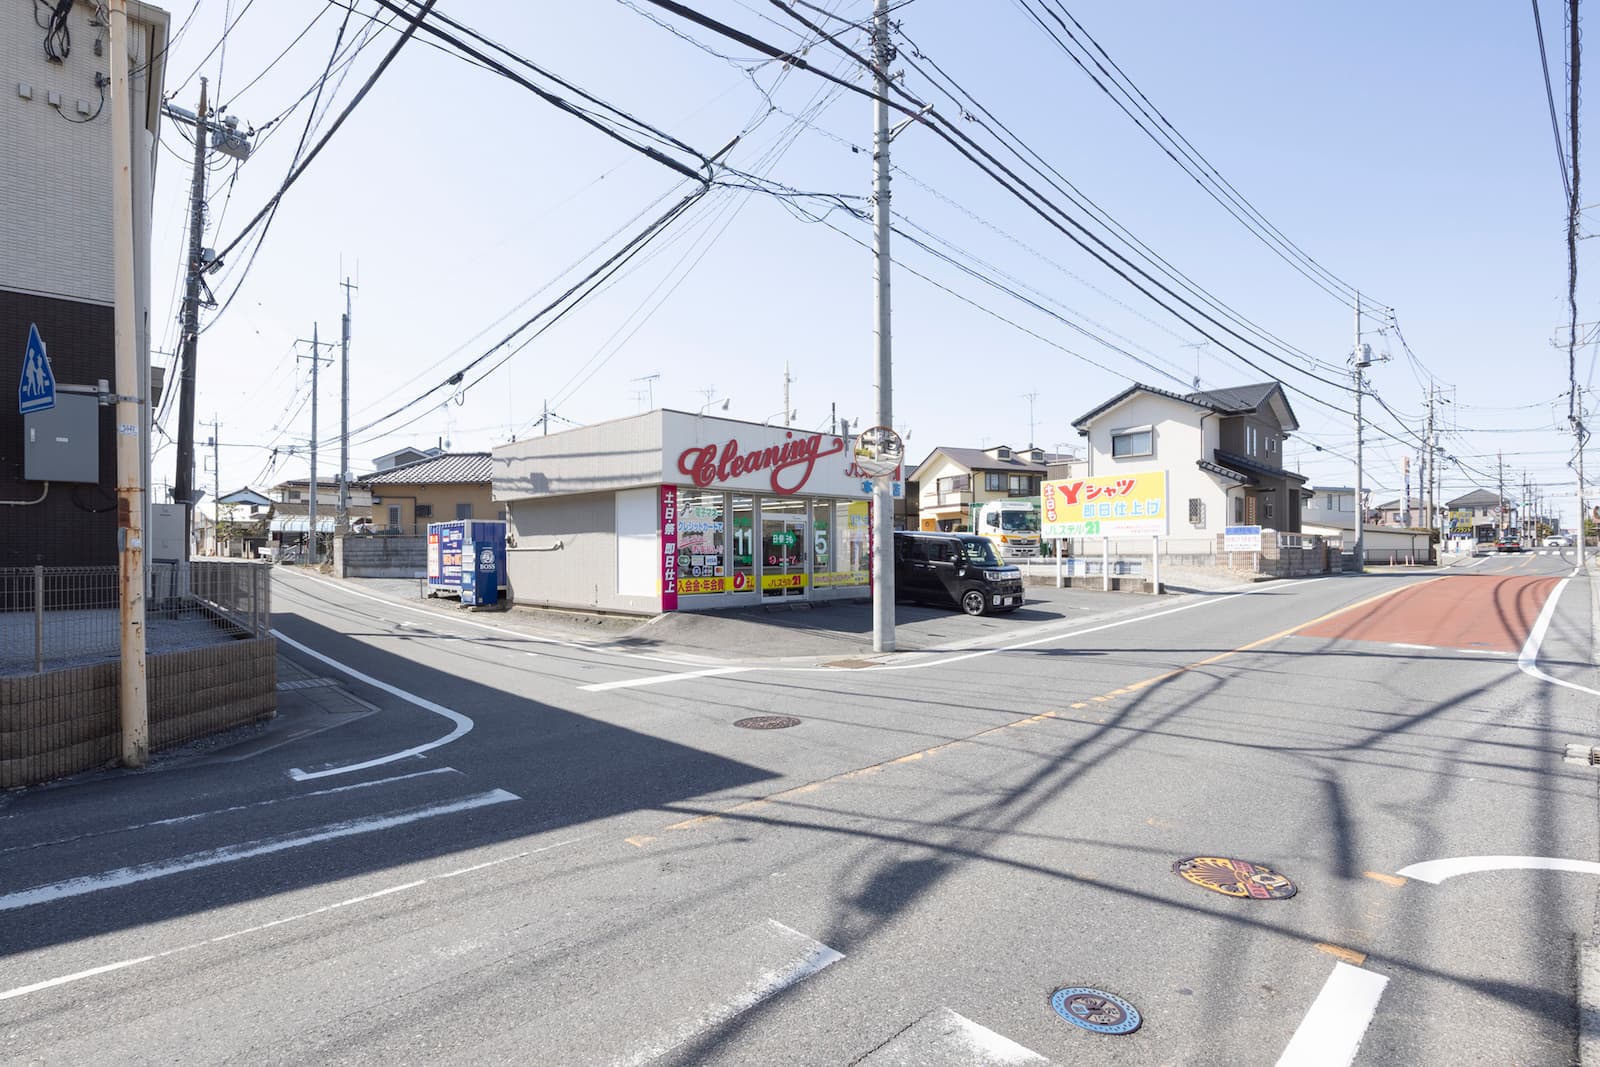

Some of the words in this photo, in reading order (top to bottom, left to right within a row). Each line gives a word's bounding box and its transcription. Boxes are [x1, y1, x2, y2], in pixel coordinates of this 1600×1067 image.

[678, 431, 844, 496] Cleaning
[1058, 479, 1135, 505] Yシャツ
[1083, 499, 1161, 518] 即日仕上げ
[735, 528, 753, 555] 11
[815, 530, 827, 554] 5
[664, 543, 676, 593] 即日仕上
[678, 579, 725, 593] 入会金・年会費
